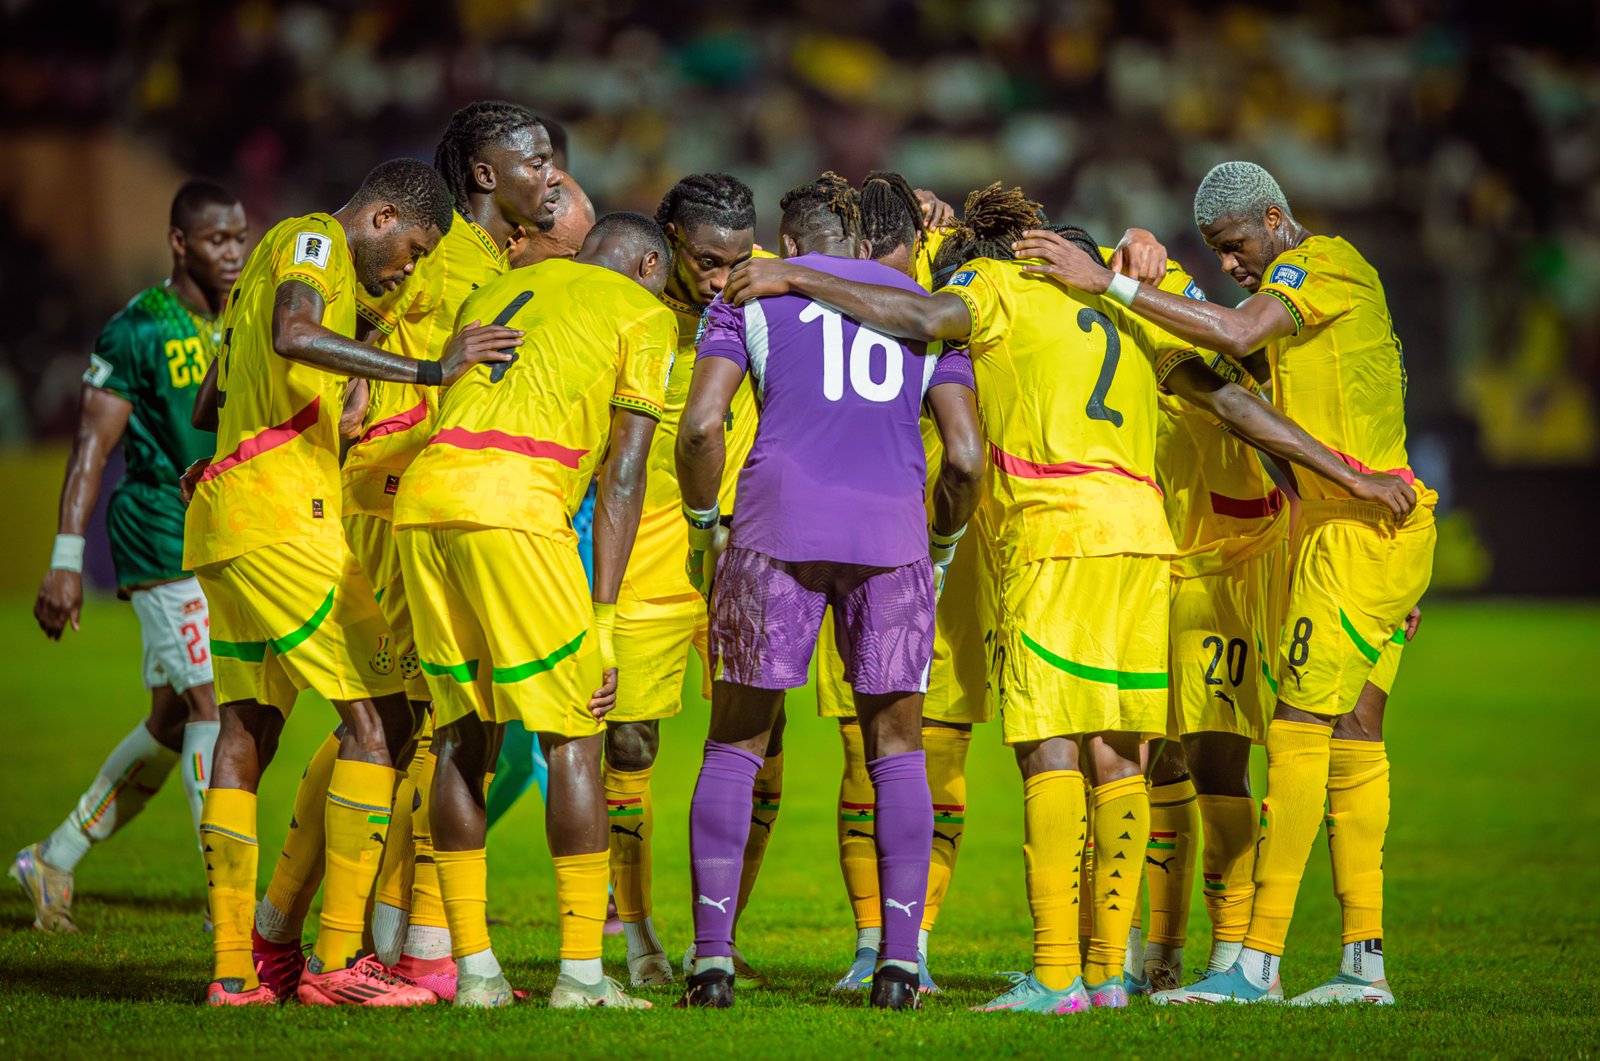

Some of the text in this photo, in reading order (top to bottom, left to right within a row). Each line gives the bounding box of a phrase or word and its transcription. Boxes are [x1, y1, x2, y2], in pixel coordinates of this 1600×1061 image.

[165, 336, 207, 389] 23
[799, 301, 904, 402] 16
[1077, 308, 1124, 428] 2
[180, 616, 209, 665] 2
[1202, 635, 1248, 687] 20
[1288, 616, 1313, 666] 8
[1261, 952, 1272, 984] ESIGN
[1353, 941, 1362, 976] EDESIGN
